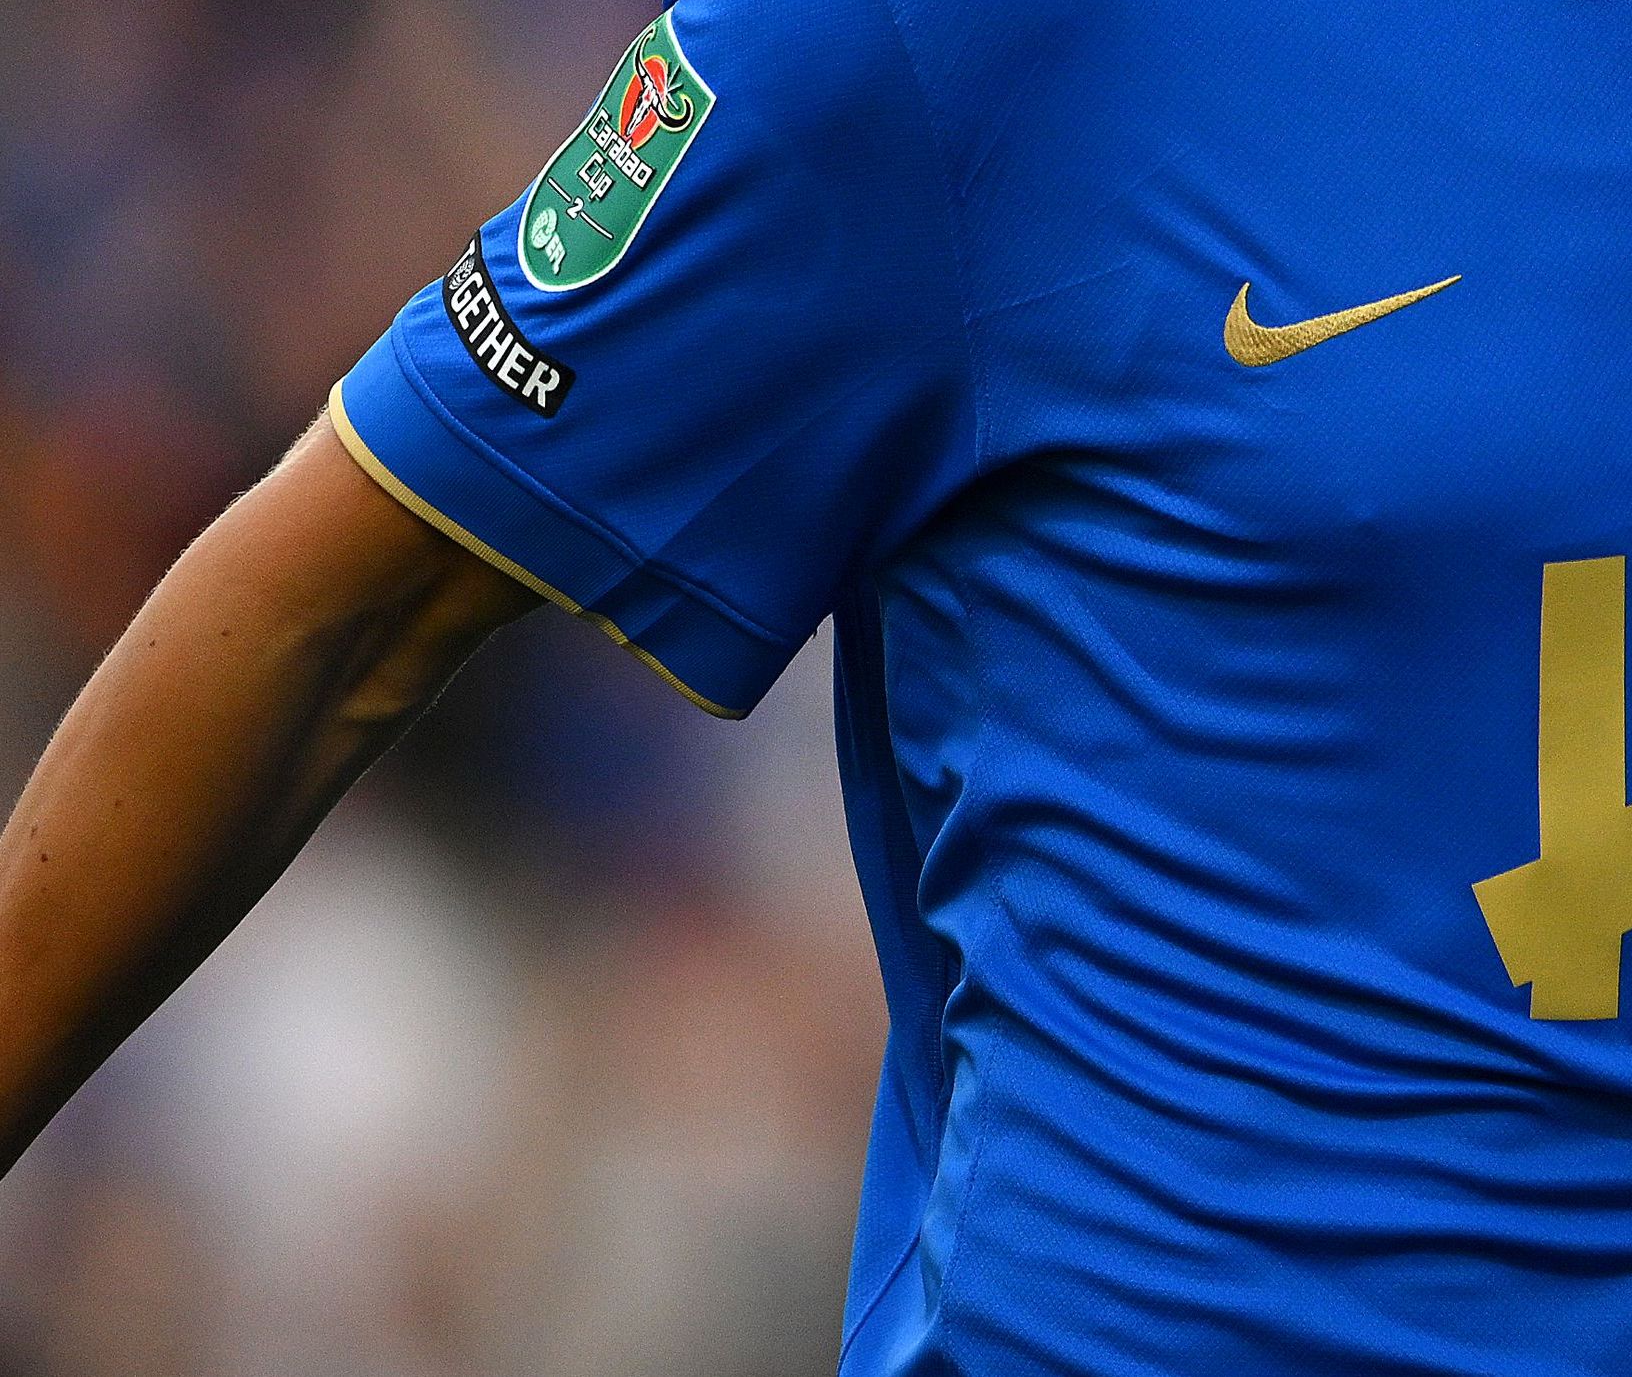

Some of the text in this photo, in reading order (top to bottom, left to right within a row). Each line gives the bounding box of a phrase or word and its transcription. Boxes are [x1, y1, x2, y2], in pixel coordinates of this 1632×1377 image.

[587, 108, 653, 189] Carabao
[577, 150, 614, 200] Cup
[566, 197, 584, 220] 2
[545, 232, 566, 274] EFL
